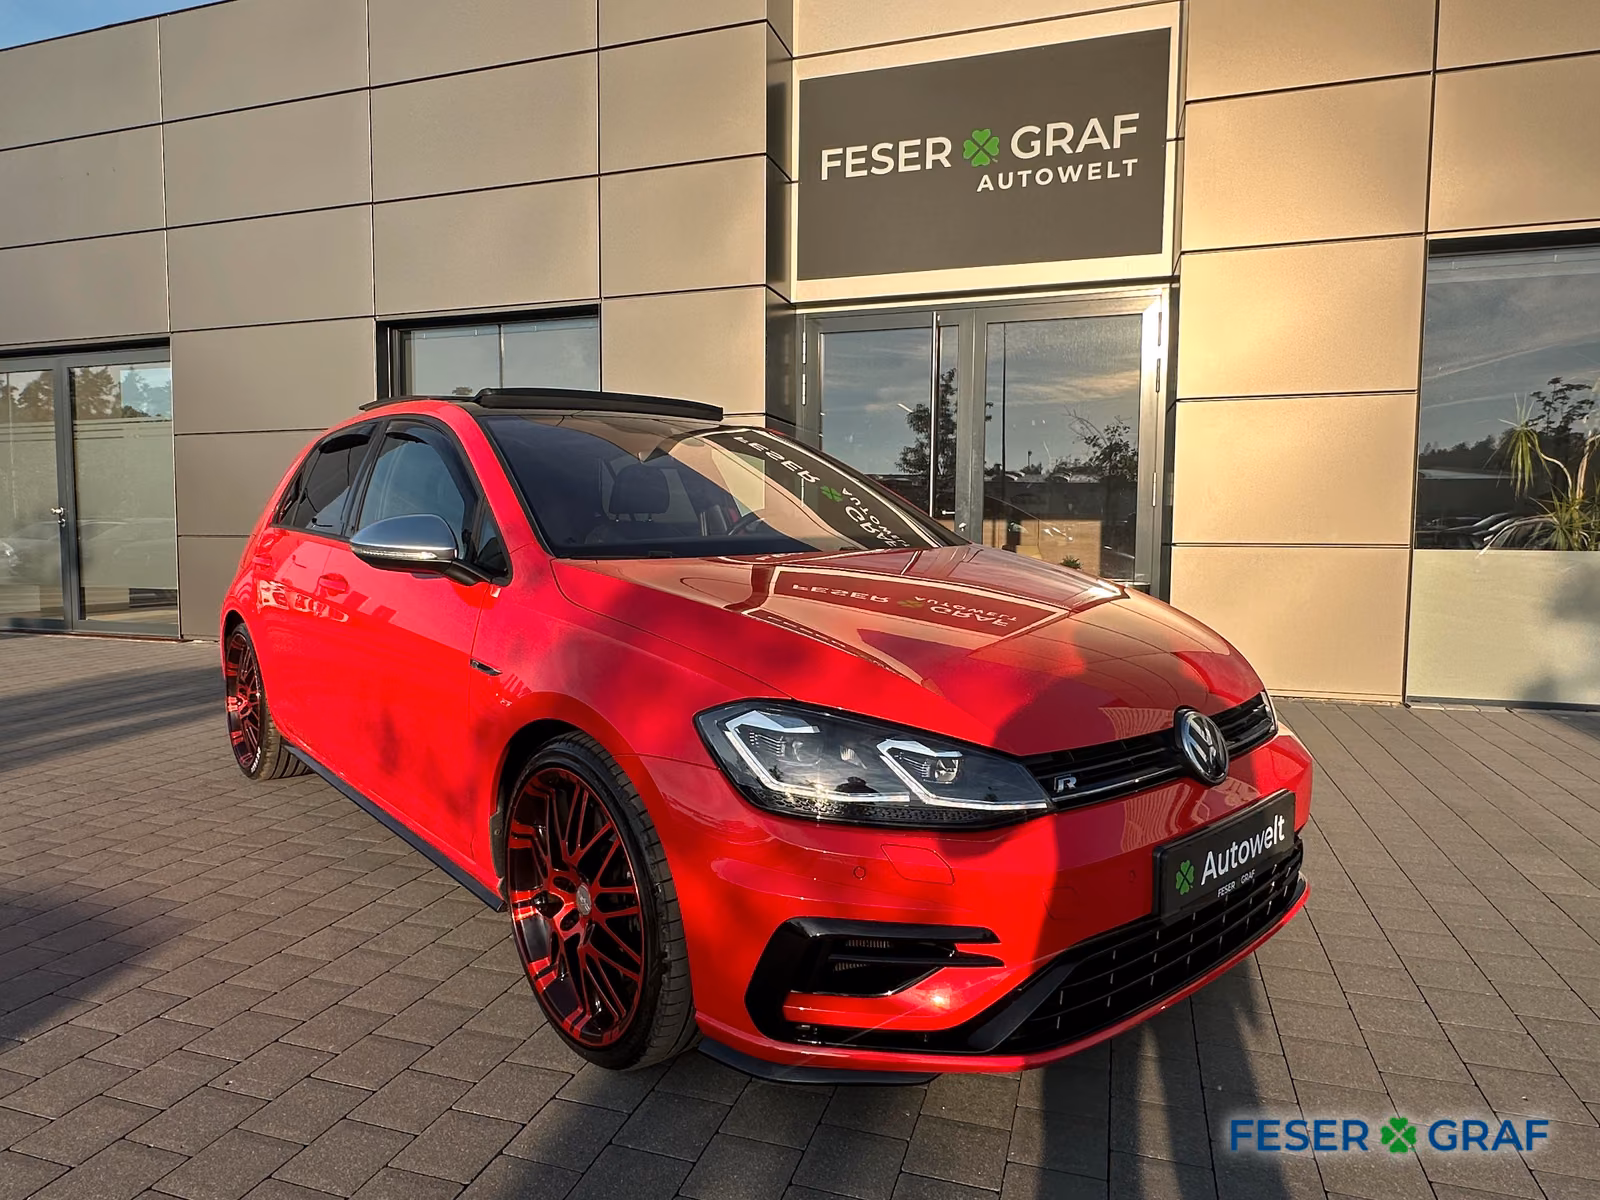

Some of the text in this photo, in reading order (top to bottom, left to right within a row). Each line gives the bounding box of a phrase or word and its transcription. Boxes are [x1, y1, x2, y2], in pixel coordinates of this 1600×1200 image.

[820, 112, 1140, 181] FESER GRAF
[976, 158, 1139, 192] AUTOWELT
[1054, 773, 1077, 793] R
[1200, 814, 1286, 886] Autowelt
[1217, 869, 1256, 898] FESER GRAF
